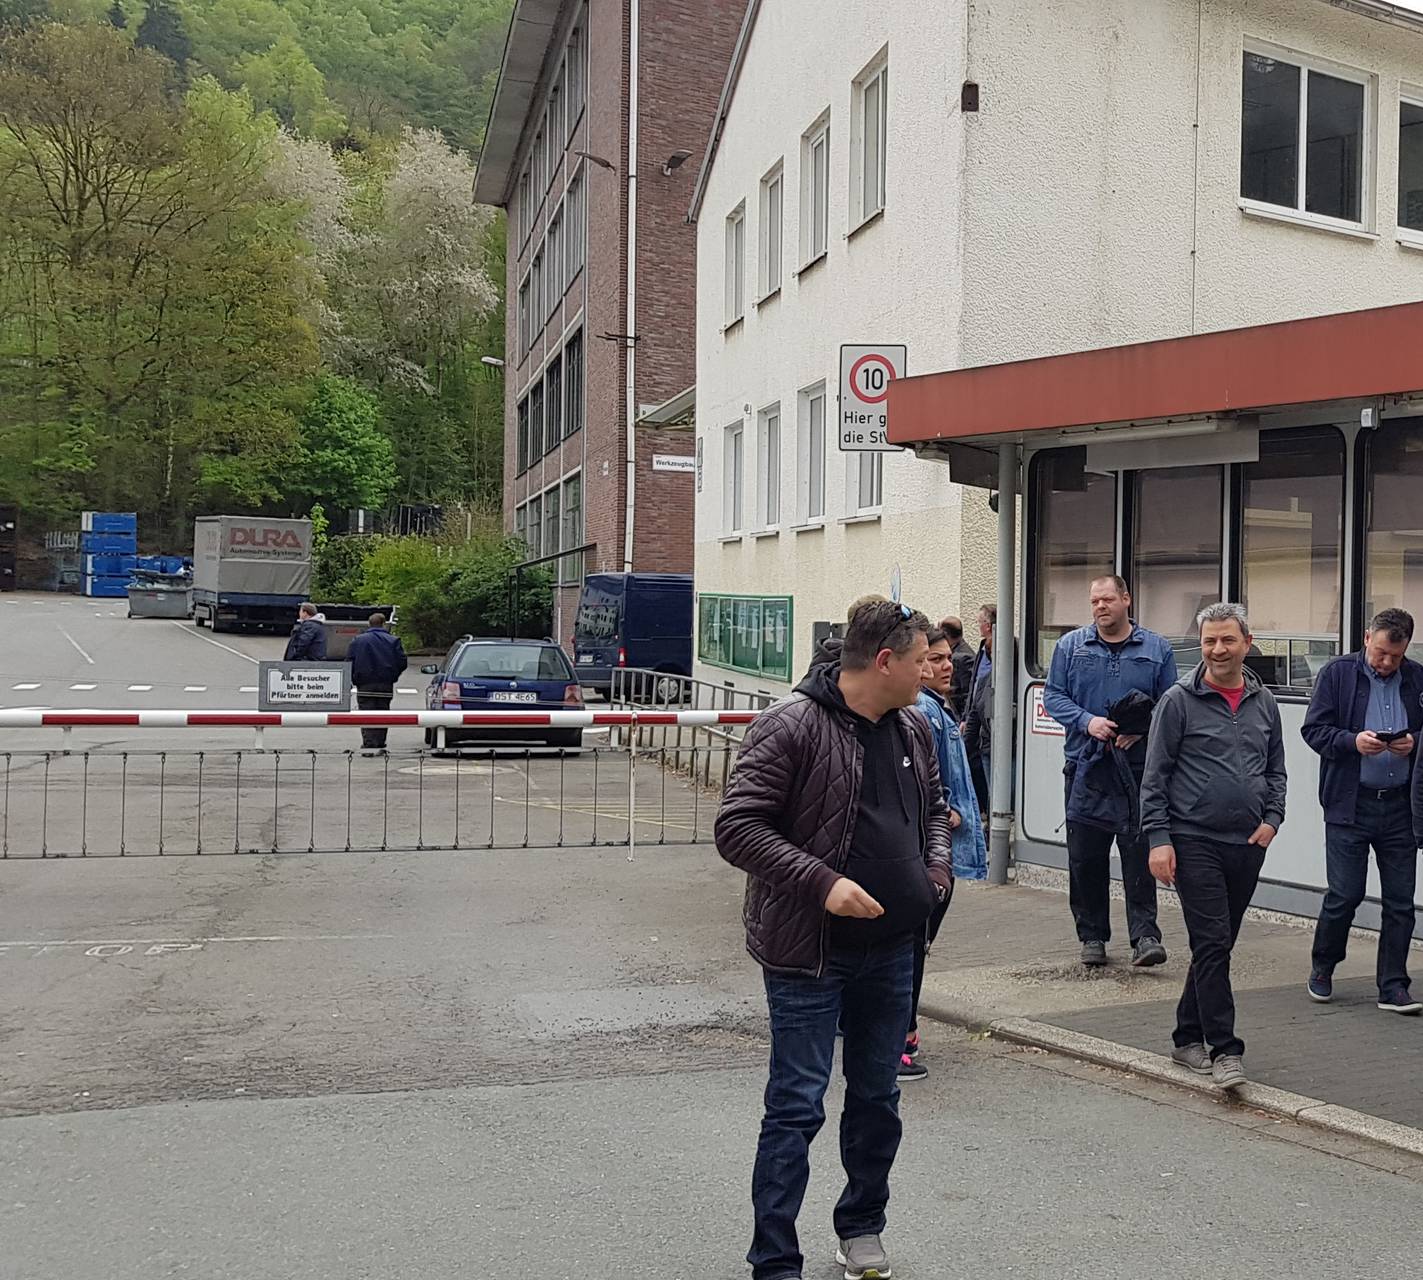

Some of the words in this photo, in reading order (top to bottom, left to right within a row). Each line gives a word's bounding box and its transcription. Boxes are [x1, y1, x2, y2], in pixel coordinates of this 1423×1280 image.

[863, 368, 884, 390] 10
[844, 411, 874, 424] Hier
[843, 431, 864, 443] die
[229, 527, 304, 548] DURA
[297, 674, 330, 682] Besucher
[271, 691, 302, 699] Pförtner
